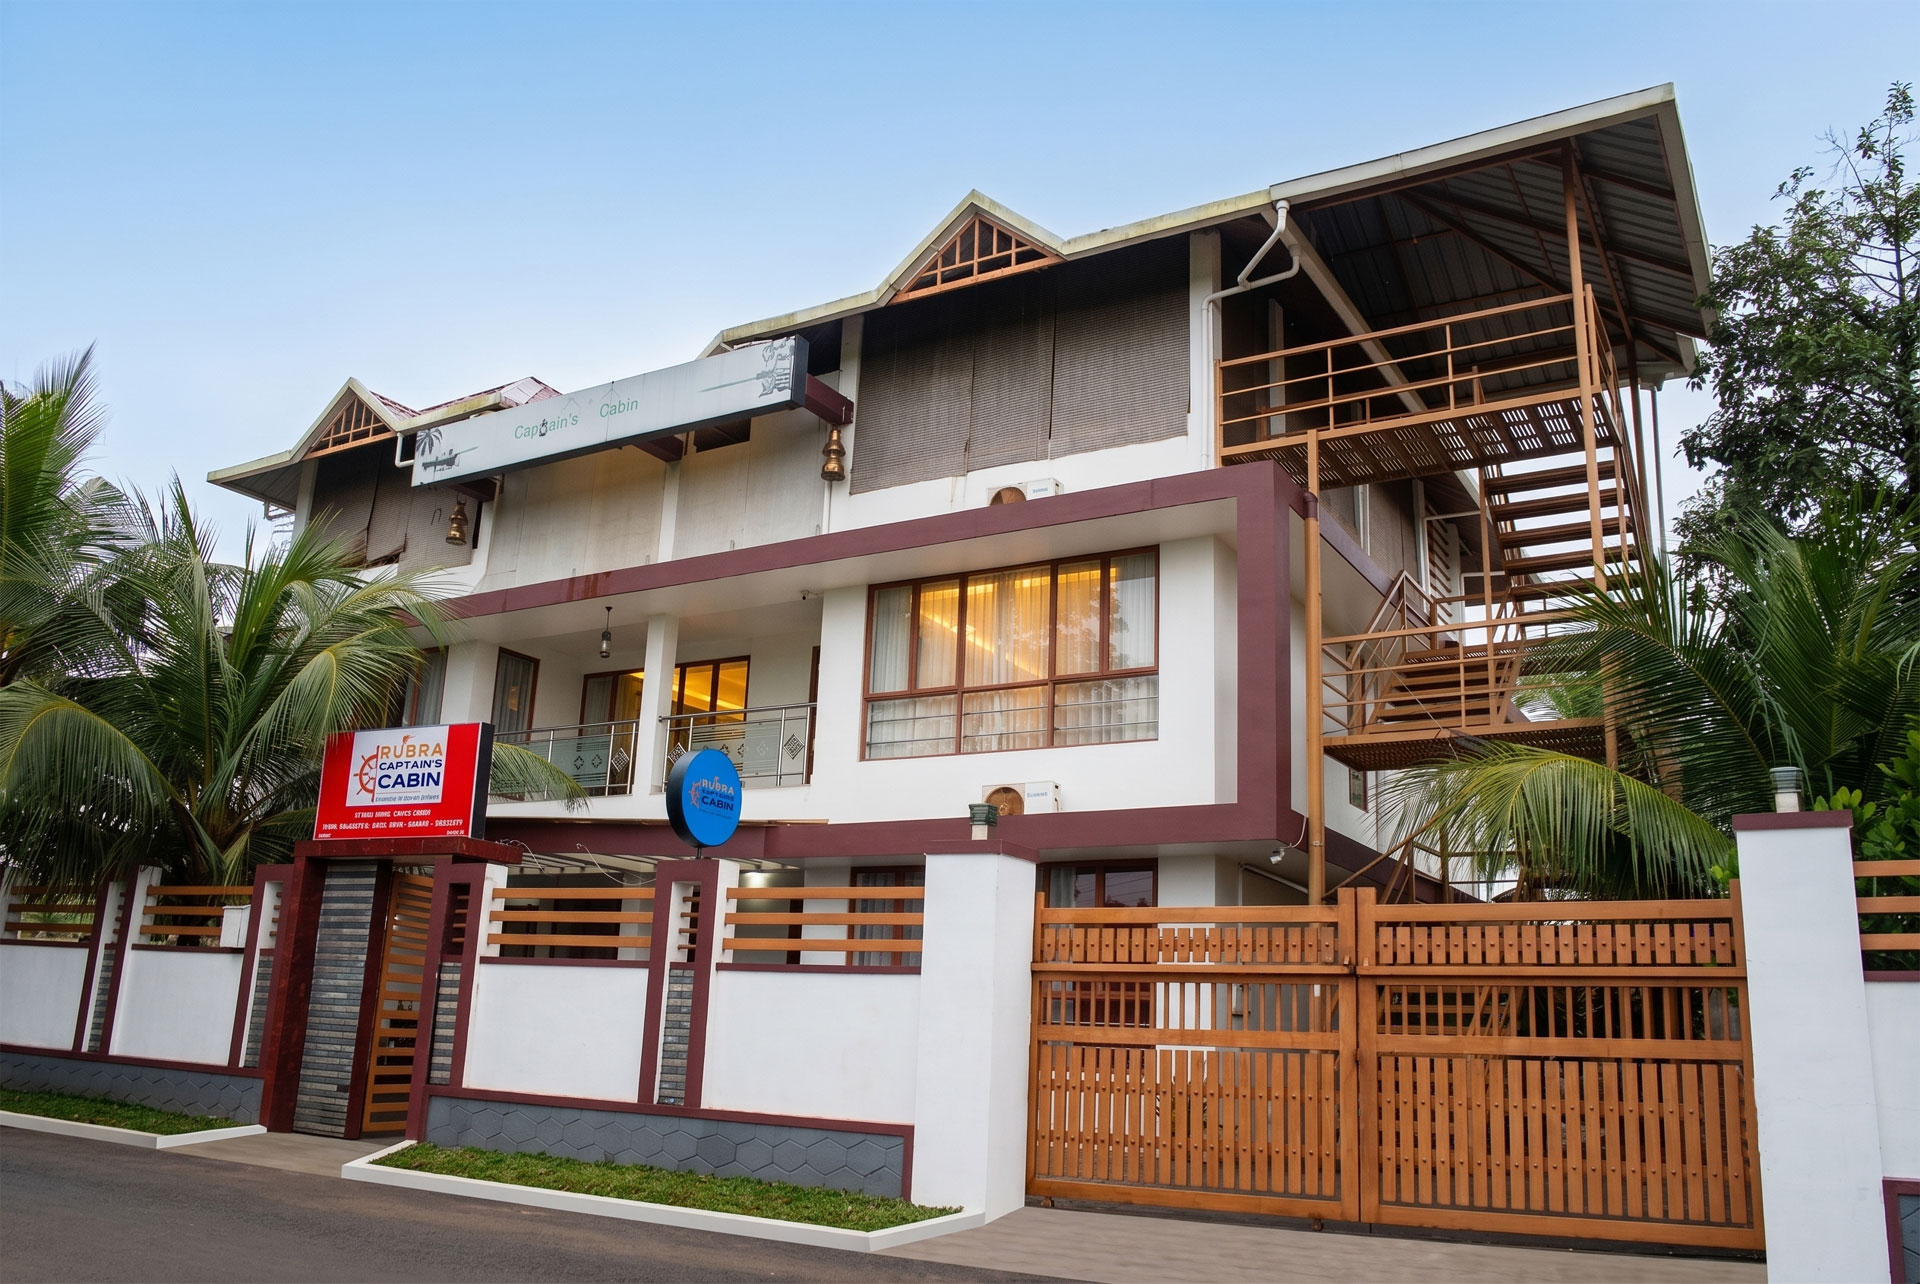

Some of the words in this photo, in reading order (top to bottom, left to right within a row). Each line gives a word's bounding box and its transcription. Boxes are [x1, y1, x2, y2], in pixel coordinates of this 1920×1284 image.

[600, 398, 639, 418] Cabin
[380, 742, 443, 760] RUBRA
[379, 758, 443, 771] CAPTAIN'S
[378, 772, 441, 789] CABIN
[701, 778, 735, 796] RUBRA
[701, 795, 734, 812] CABIN
